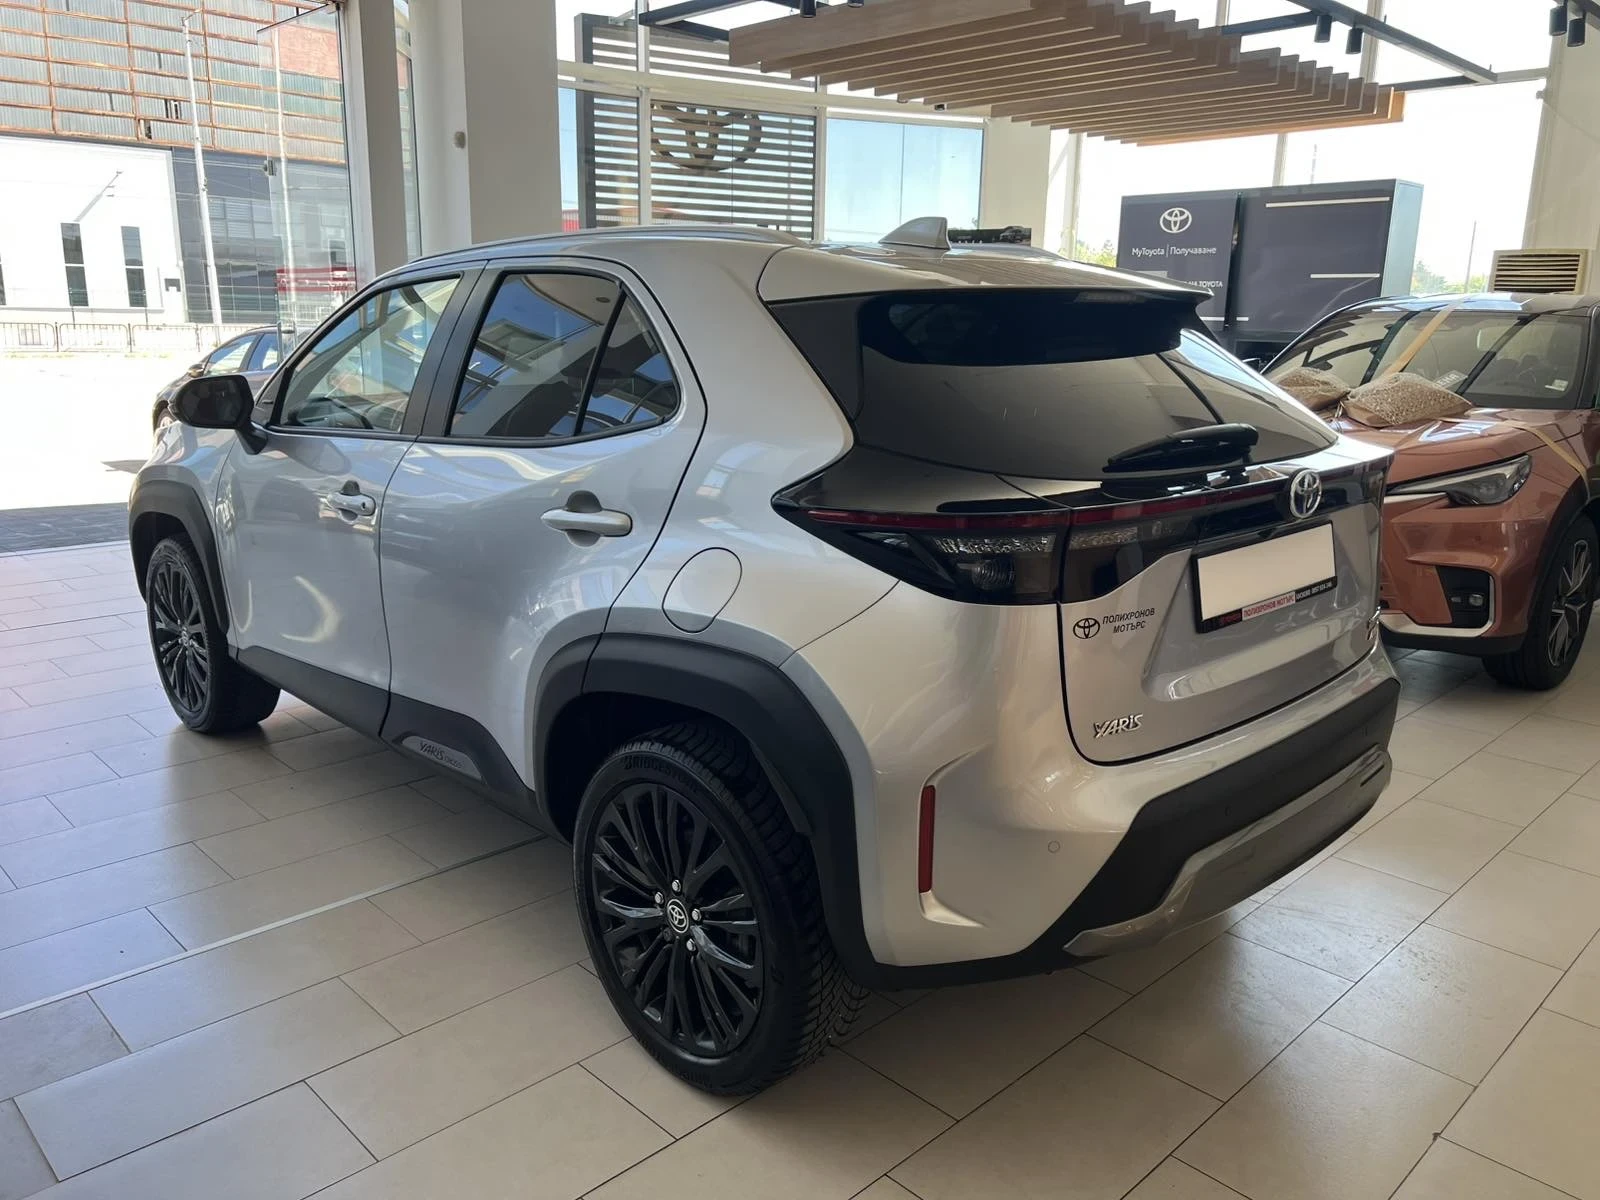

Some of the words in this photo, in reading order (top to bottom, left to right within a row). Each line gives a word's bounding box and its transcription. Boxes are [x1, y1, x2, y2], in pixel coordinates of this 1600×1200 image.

[1131, 247, 1165, 257] MyToyota
[1170, 247, 1217, 256] Получаване
[1198, 280, 1223, 289] TOYOTA
[1102, 607, 1156, 625] ПОЛИХРОНОВ
[1112, 620, 1147, 634] МОТЪРС
[1093, 713, 1144, 739] YARIS
[419, 741, 446, 761] YARIS
